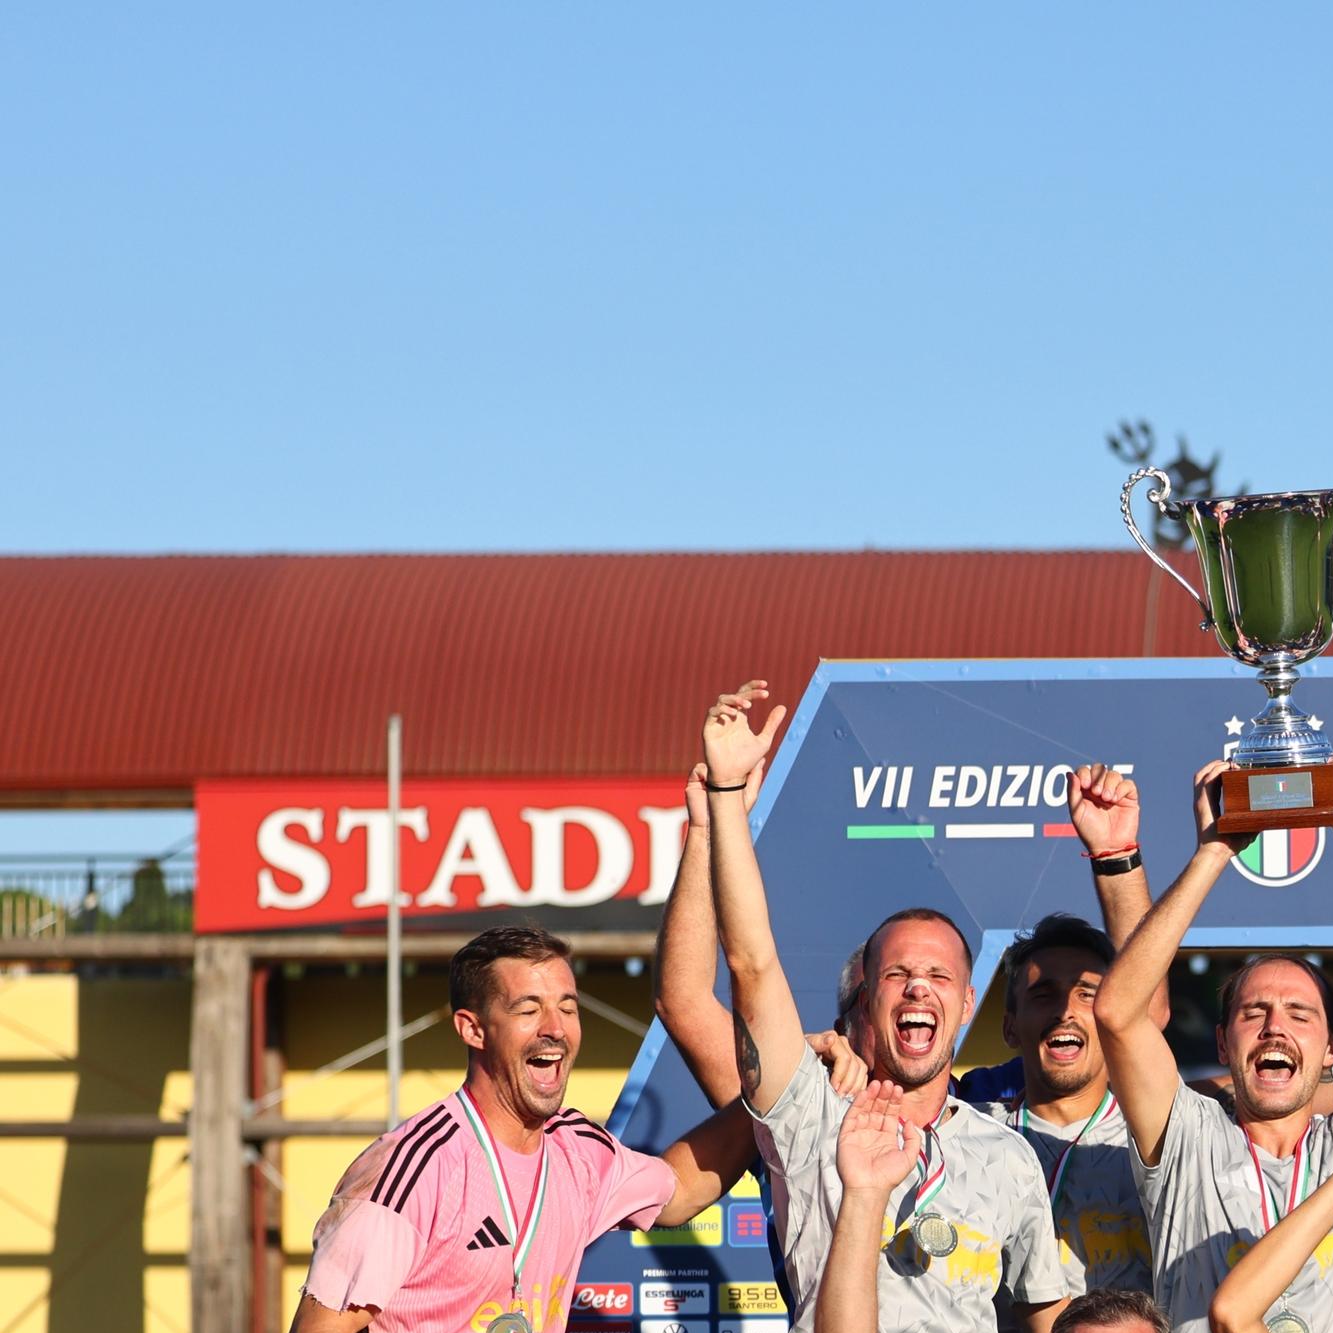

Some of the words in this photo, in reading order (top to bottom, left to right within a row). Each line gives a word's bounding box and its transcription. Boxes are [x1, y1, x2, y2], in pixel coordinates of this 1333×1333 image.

[851, 765, 914, 810] VII
[928, 764, 1134, 808] EDIZIO
[677, 1269, 709, 1278] PARTNER
[645, 1289, 705, 1298] ESSELUNGA
[728, 1302, 777, 1310] SANTERO
